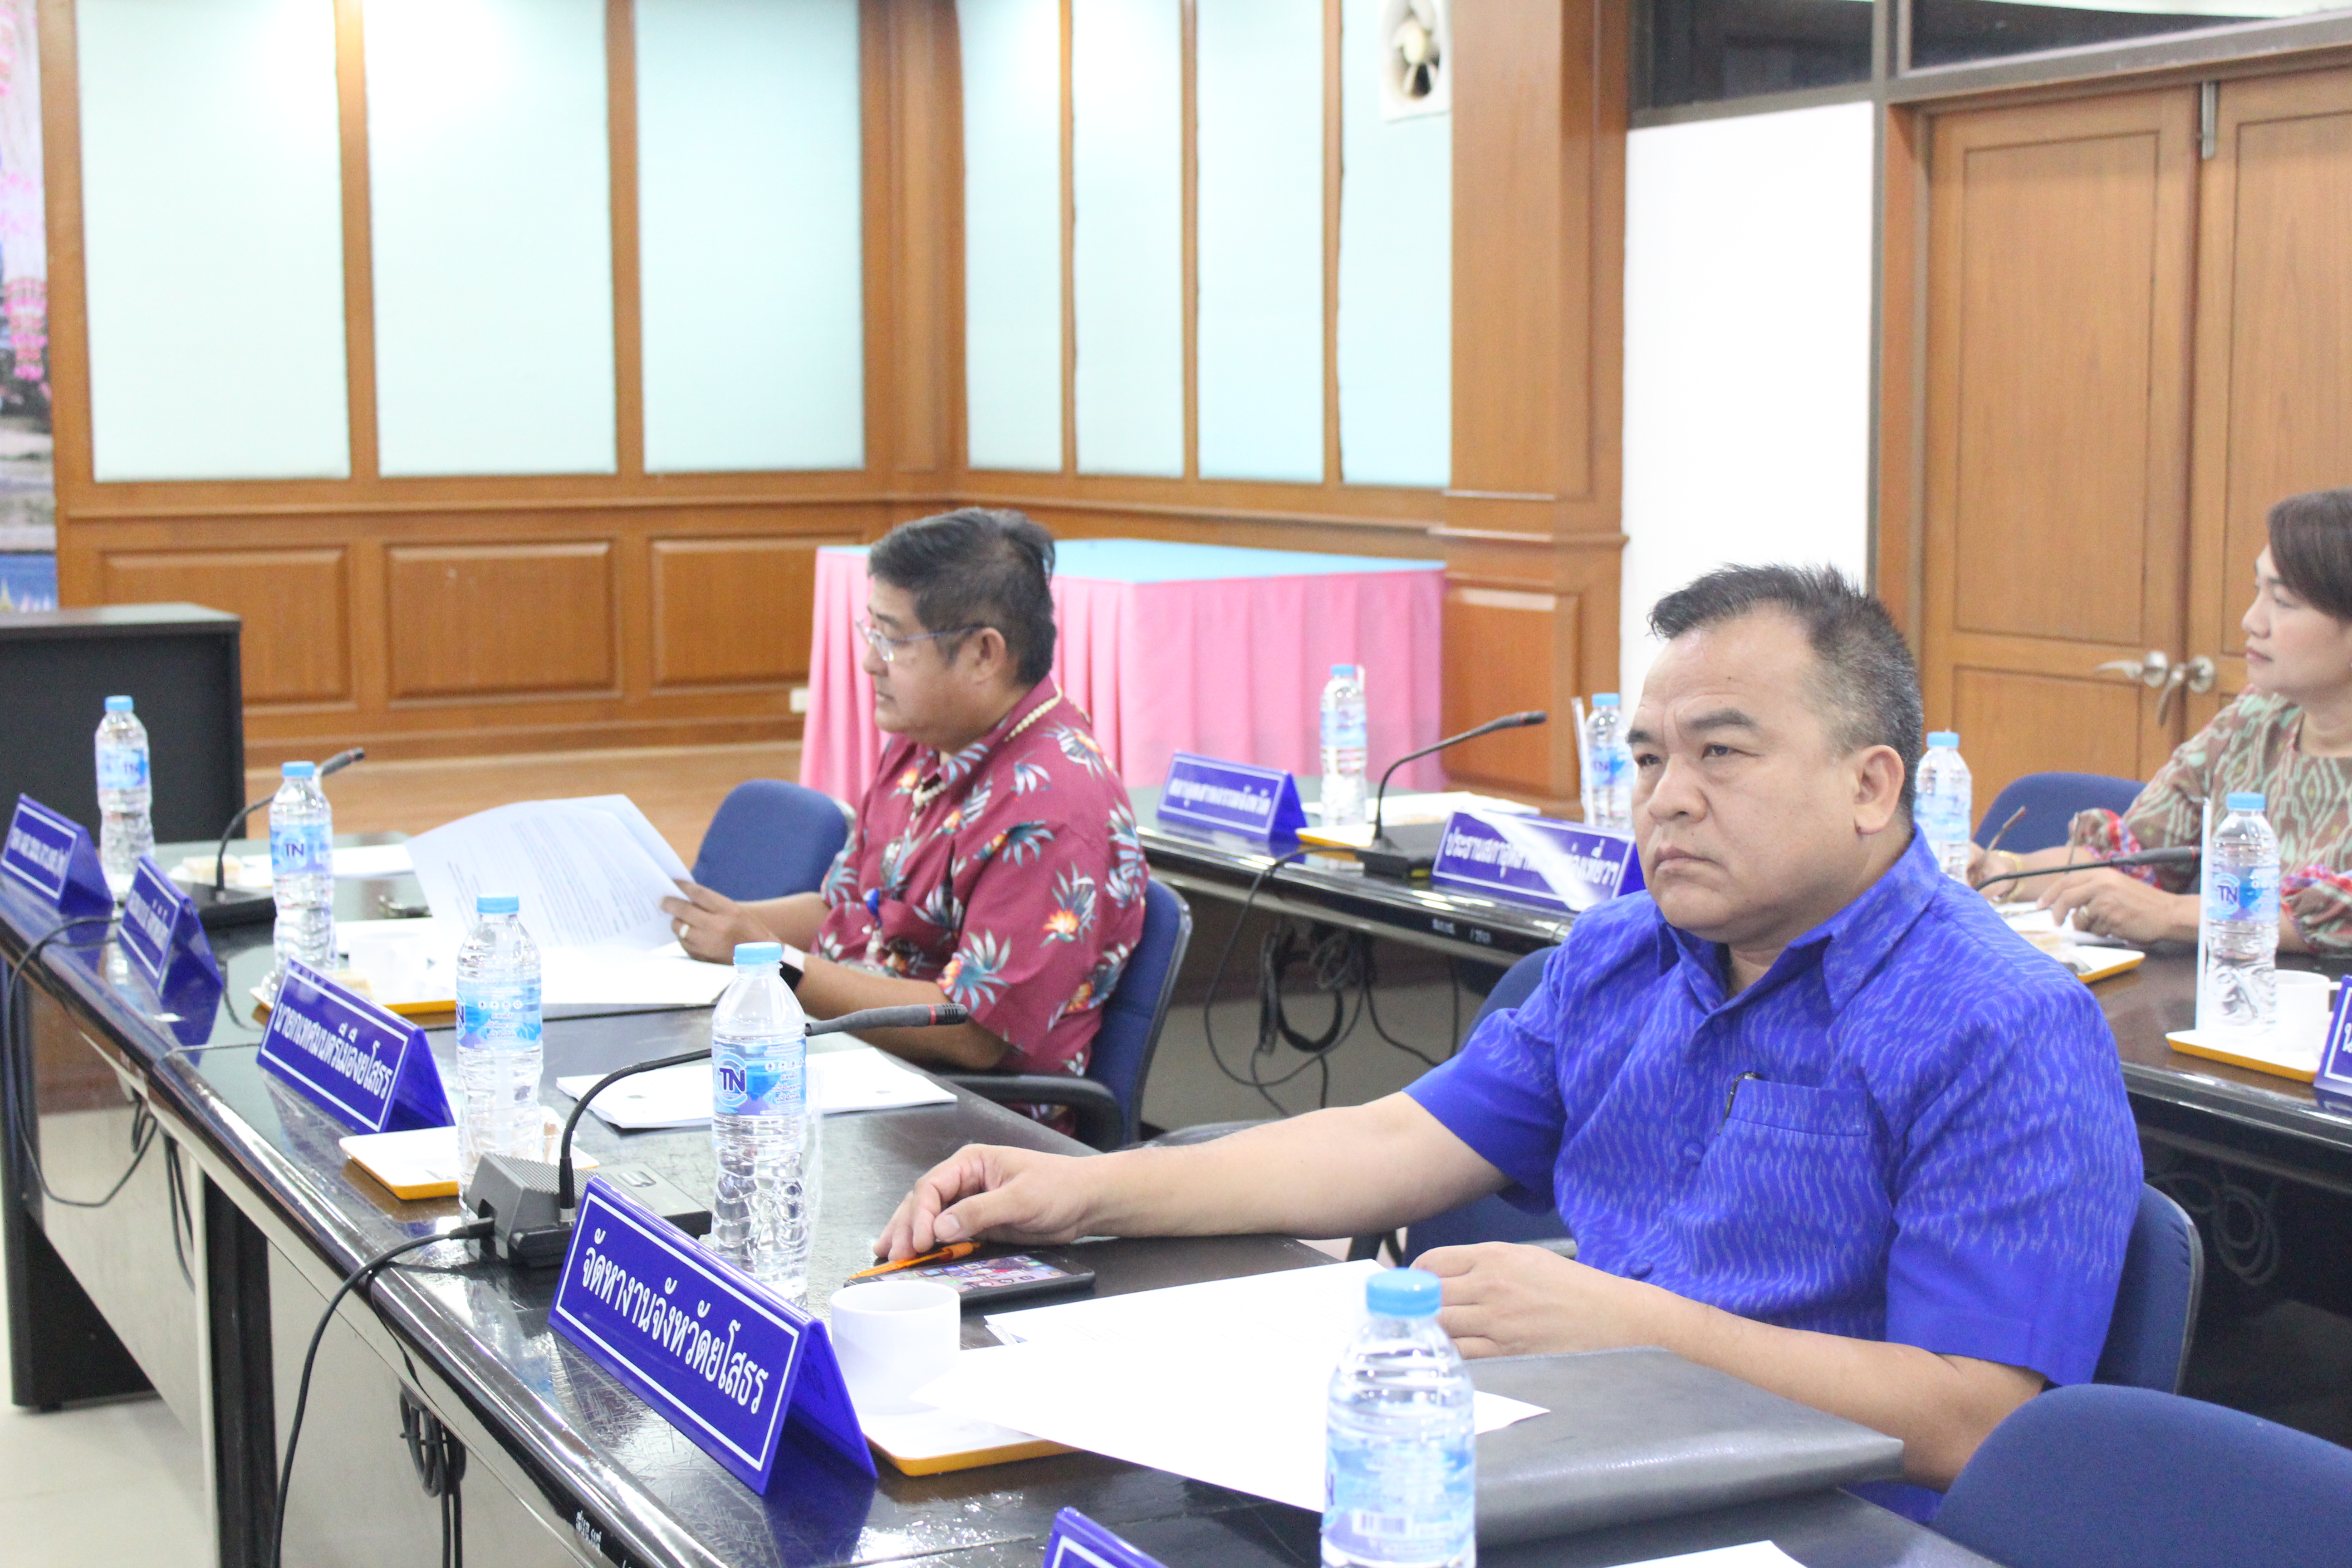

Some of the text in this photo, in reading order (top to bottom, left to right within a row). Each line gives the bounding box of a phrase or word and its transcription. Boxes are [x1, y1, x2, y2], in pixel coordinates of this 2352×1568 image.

[2217, 885, 2237, 902] TN
[719, 1067, 745, 1092] TN
[582, 1227, 770, 1415] จัดหางานจังหวัดยโสธร
